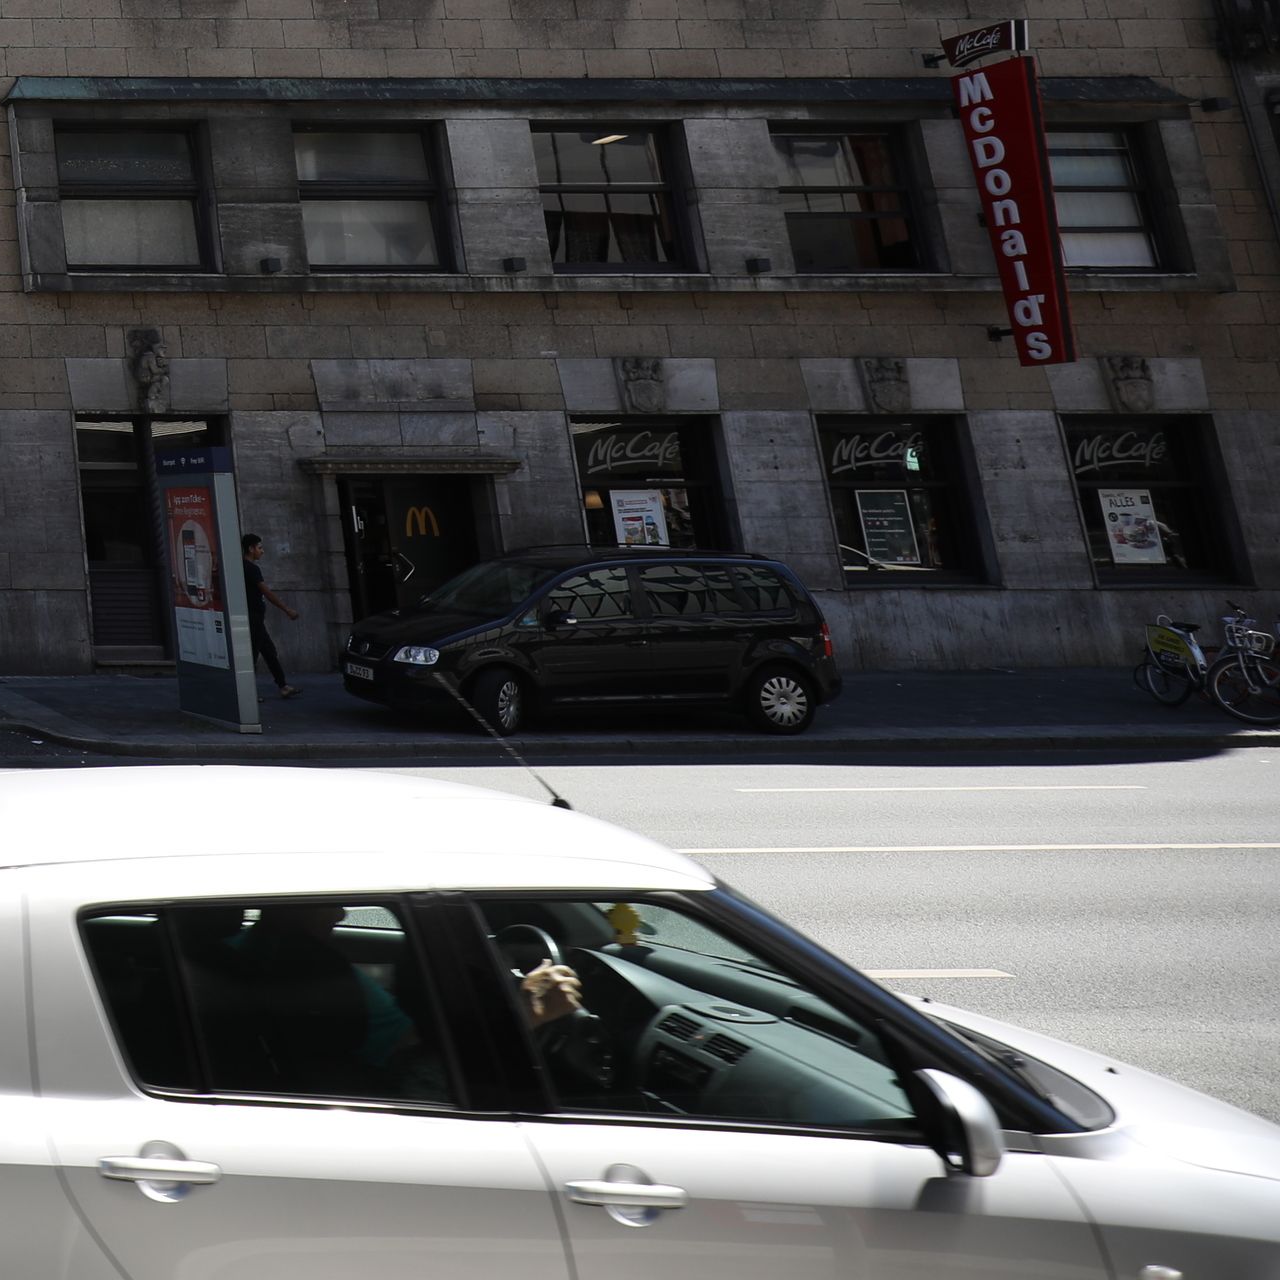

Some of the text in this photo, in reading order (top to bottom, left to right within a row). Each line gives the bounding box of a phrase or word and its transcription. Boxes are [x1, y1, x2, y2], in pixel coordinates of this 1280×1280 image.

[955, 27, 1001, 55] McCafé
[958, 72, 1053, 360] McDonald's
[588, 431, 680, 470] McCafé
[833, 431, 924, 470] McCafé
[1075, 431, 1167, 470] McCafé
[1109, 496, 1136, 507] ALLES
